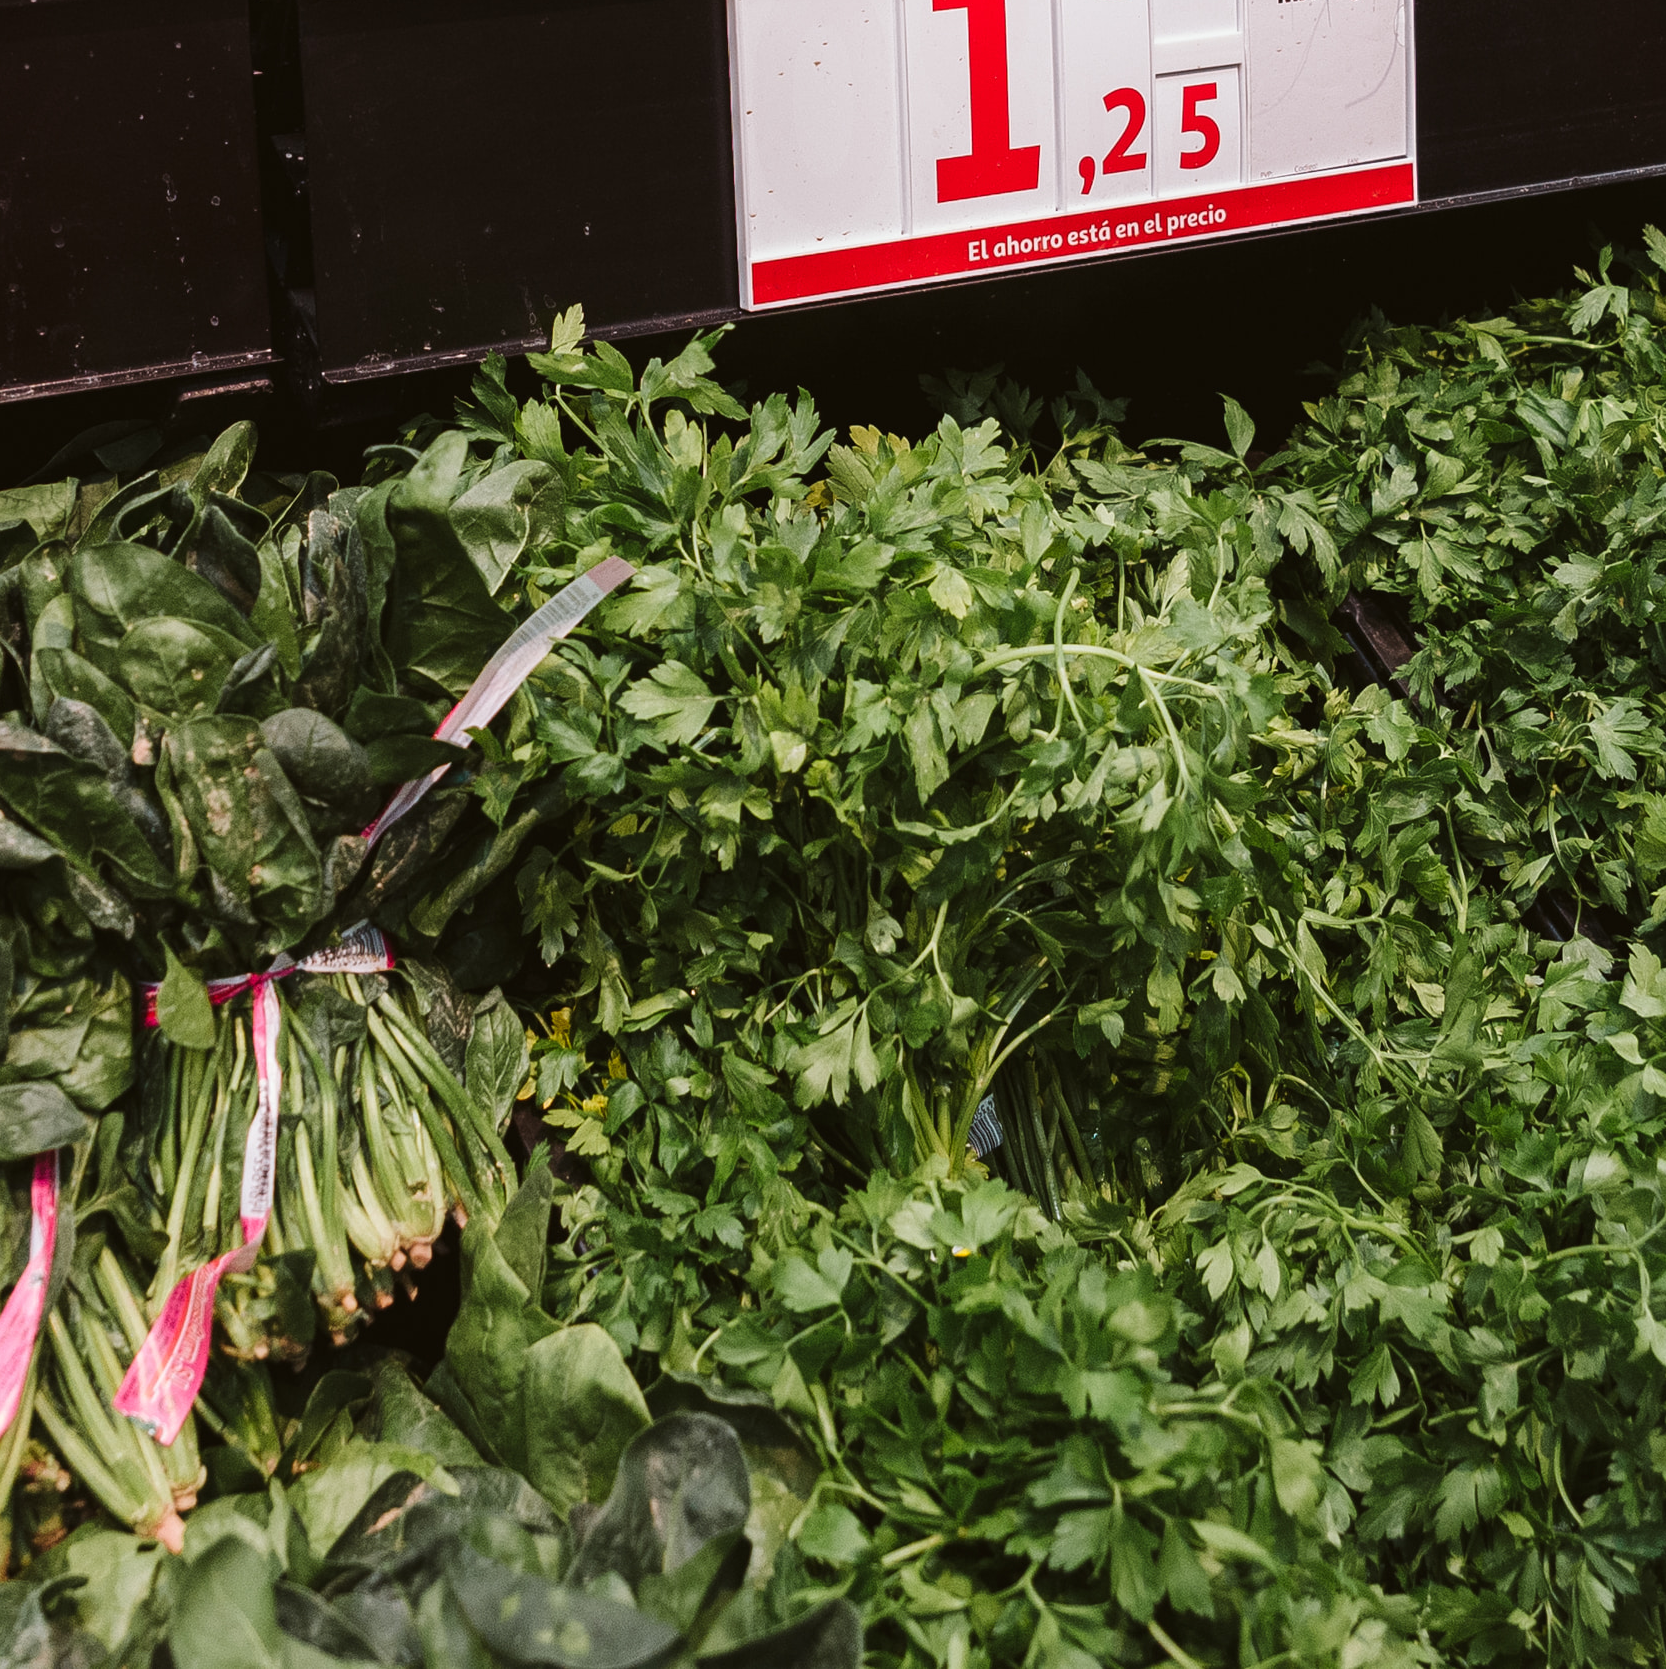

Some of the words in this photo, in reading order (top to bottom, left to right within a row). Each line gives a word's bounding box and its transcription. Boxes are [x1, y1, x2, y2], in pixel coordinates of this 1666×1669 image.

[968, 240, 988, 262] El
[993, 234, 1063, 258] ahorro
[1067, 220, 1110, 245] está
[1115, 221, 1139, 239] en
[1144, 213, 1162, 234] el
[1167, 204, 1226, 235] precio
